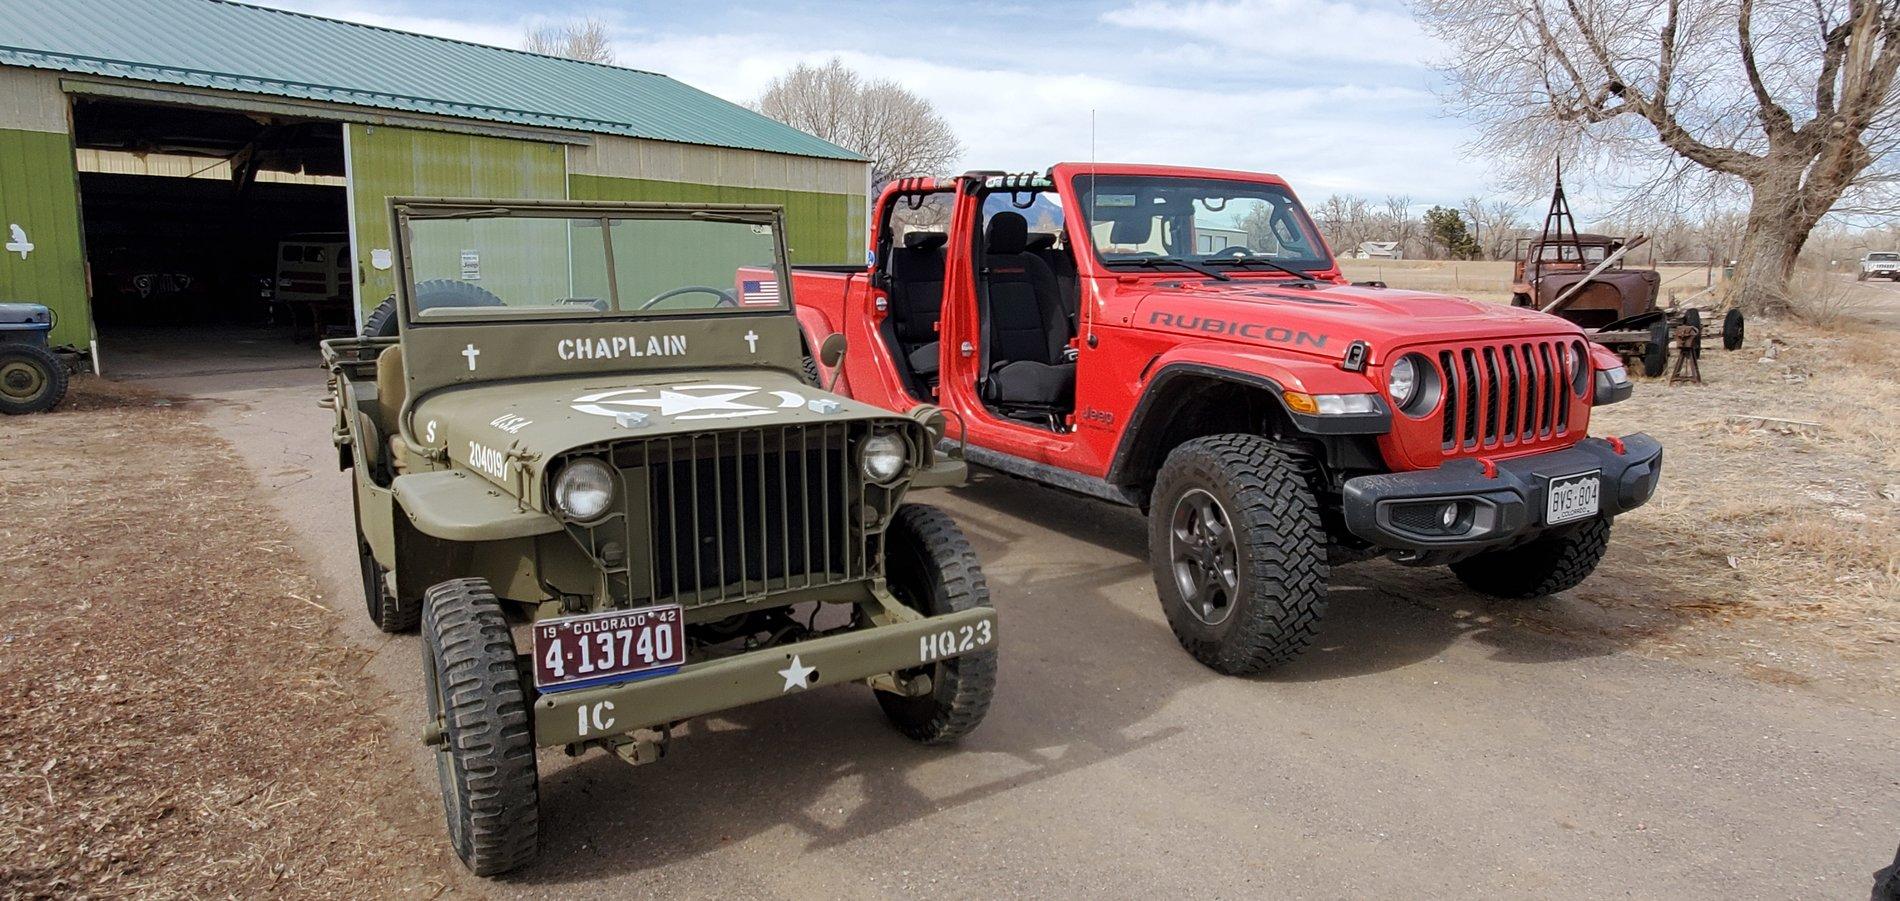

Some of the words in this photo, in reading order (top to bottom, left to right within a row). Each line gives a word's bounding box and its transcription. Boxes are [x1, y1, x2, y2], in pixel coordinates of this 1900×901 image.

[1149, 311, 1329, 348] RUBICON
[558, 335, 687, 360] CHAPLAIN
[1083, 406, 1114, 424] Jeep
[426, 420, 437, 443] S
[543, 627, 557, 639] 19
[573, 615, 646, 635] COLORADO
[659, 610, 676, 622] 42
[920, 620, 992, 662] HQ23
